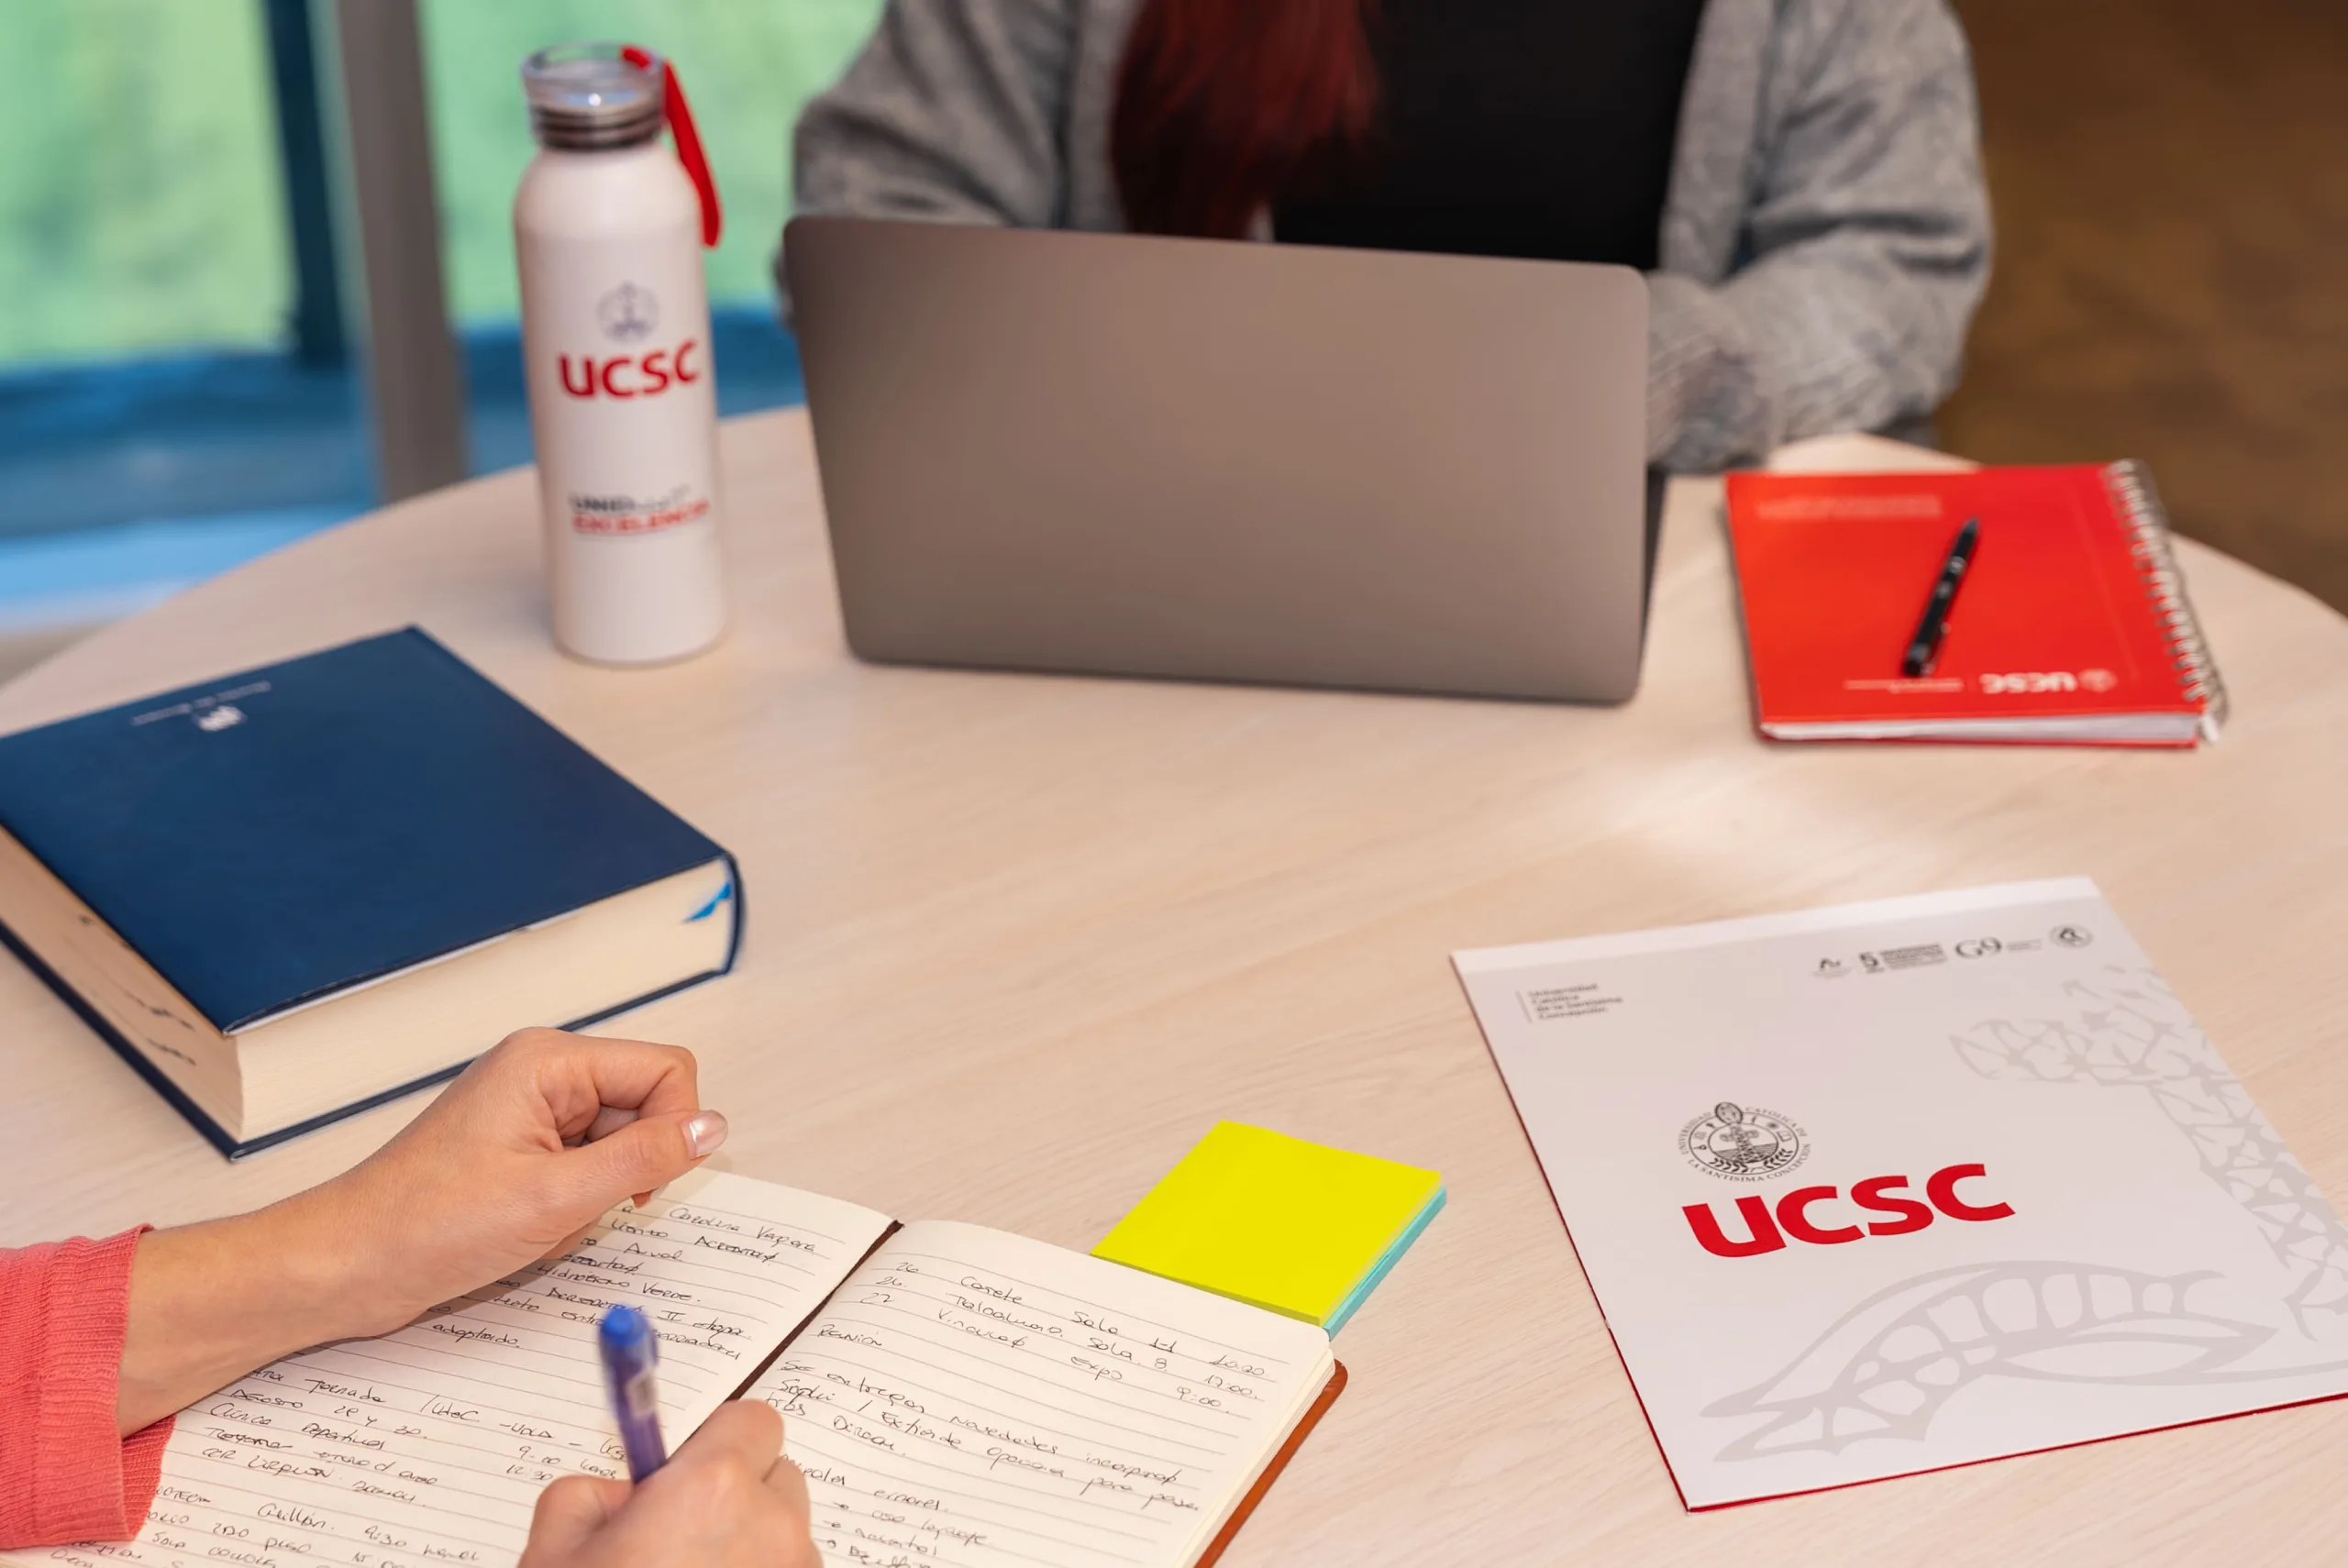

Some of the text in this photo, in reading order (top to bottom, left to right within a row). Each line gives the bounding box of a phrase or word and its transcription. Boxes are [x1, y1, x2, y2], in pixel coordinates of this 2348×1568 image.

[559, 337, 699, 397] UCSC
[1688, 1158, 1699, 1168] LA
[1701, 1165, 1765, 1182] SANTISIMA
[1682, 1163, 2016, 1257] UCSC
